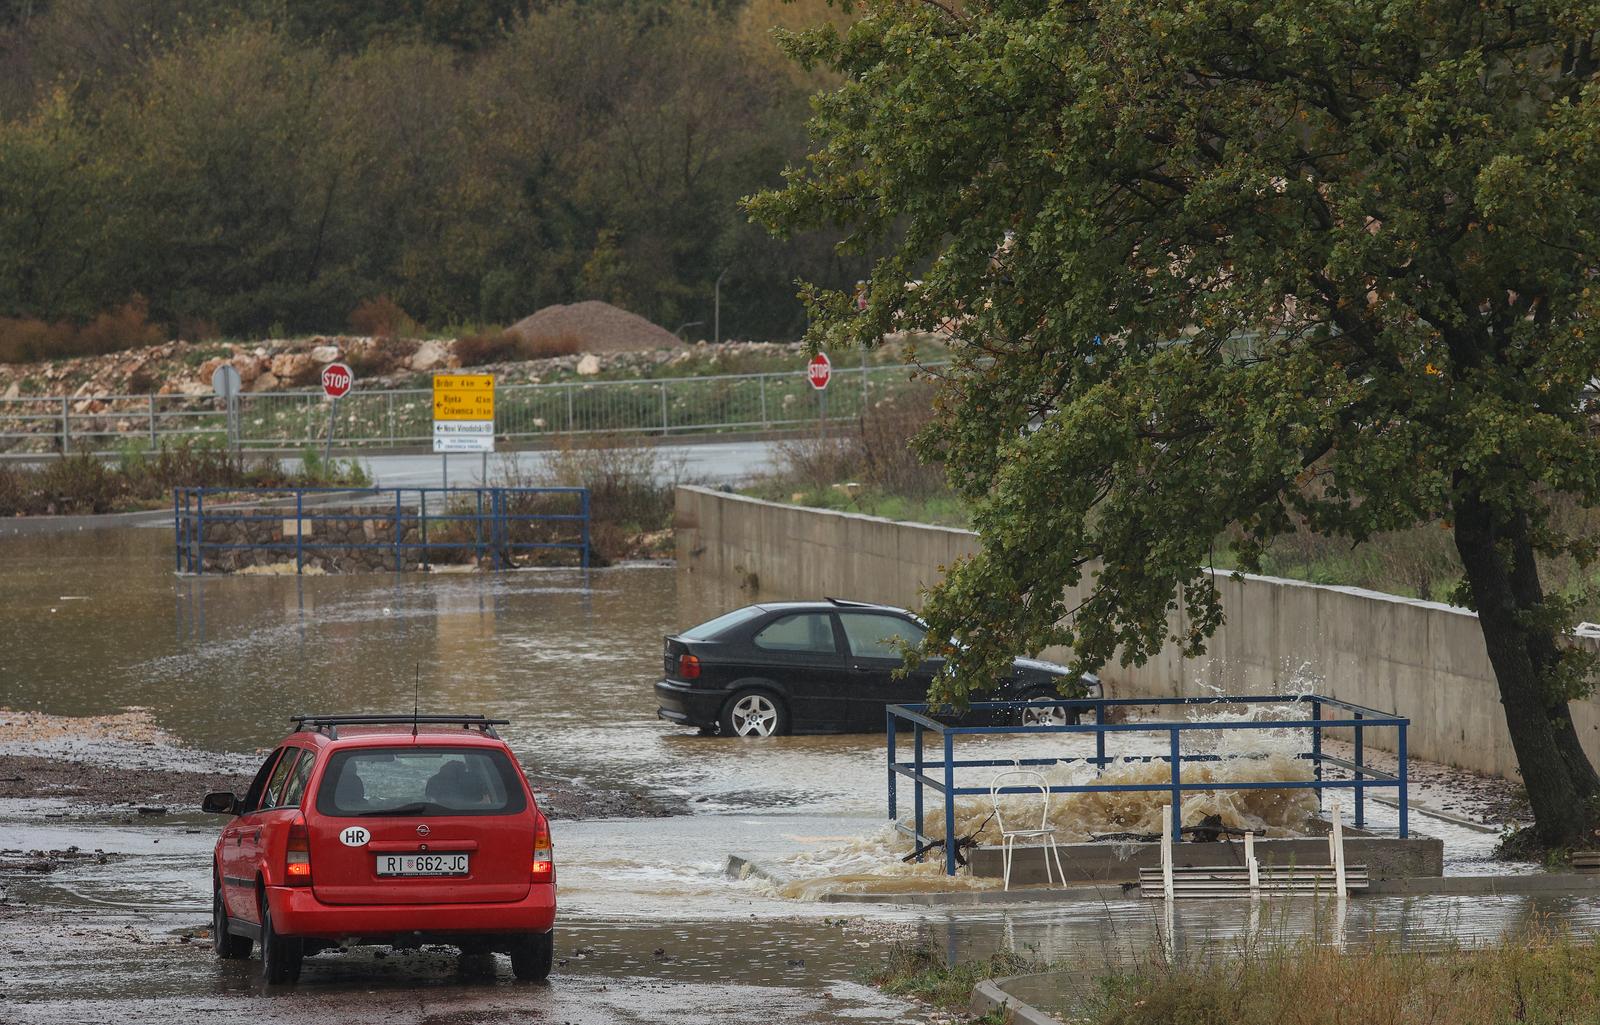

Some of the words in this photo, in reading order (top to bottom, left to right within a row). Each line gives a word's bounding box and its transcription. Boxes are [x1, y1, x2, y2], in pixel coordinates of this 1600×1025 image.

[810, 364, 828, 378] STOP
[323, 372, 349, 389] STOP
[444, 395, 461, 404] Rijeka
[444, 407, 473, 415] Crikvenica
[345, 830, 365, 843] HR
[387, 857, 402, 871] RI
[416, 856, 466, 871] 662-JC
